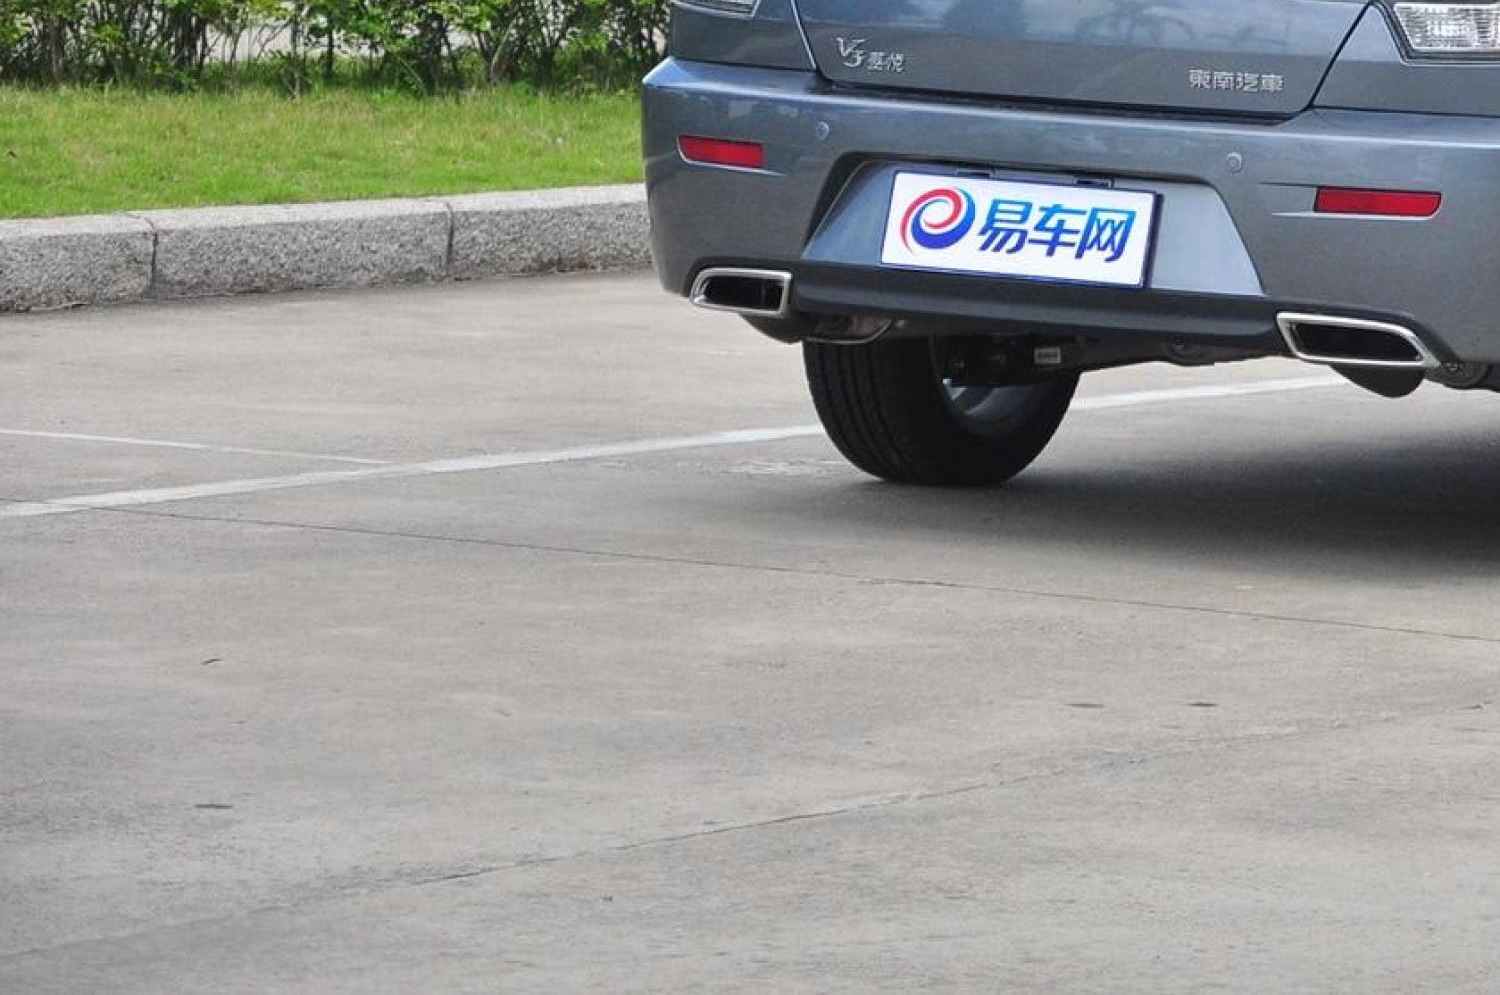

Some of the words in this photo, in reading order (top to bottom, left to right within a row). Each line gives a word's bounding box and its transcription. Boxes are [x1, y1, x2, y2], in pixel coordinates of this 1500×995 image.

[1188, 69, 1284, 93] 東南汽車
[978, 197, 1138, 263] 易车网
